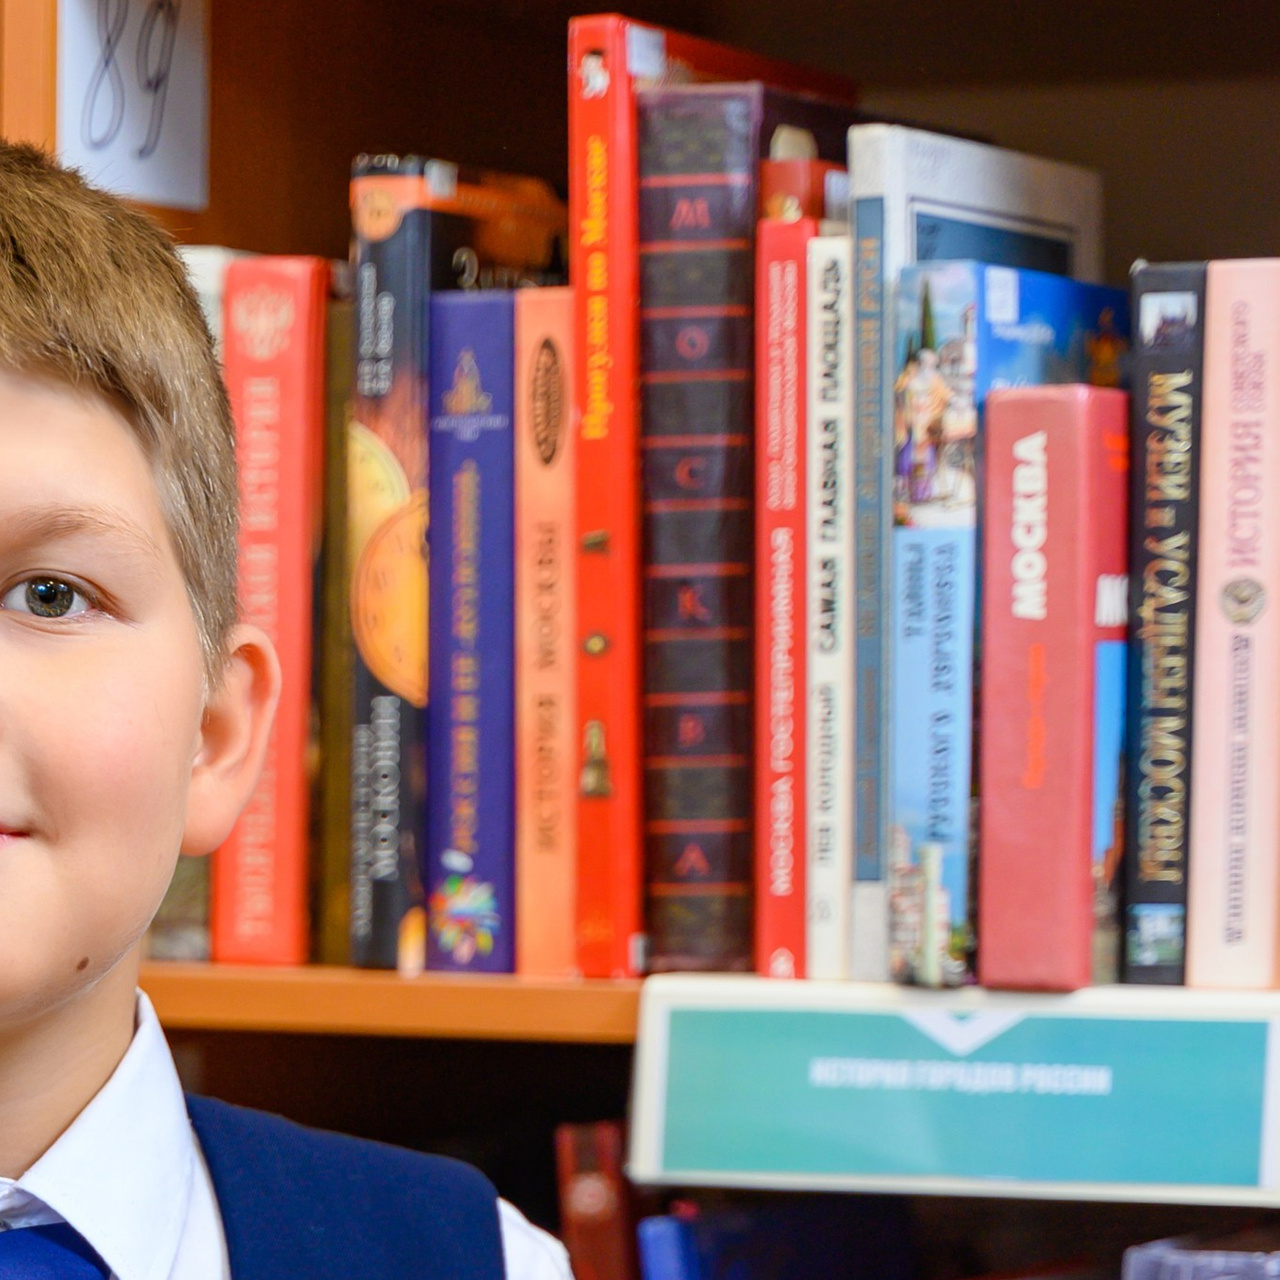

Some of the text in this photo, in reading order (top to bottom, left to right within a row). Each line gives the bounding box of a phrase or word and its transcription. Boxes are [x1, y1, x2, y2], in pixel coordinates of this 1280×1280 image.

[79, 0, 178, 127] 89
[581, 135, 609, 246] Москве
[585, 252, 609, 289] по
[817, 257, 842, 654] САМАЯ ГЛАВНАЯ ПЛОЩАДЬ
[1146, 368, 1193, 504] МУЗЕИ
[1225, 419, 1262, 568] ИСТОРИЯ
[1009, 431, 1048, 620] МОСКВА
[1136, 531, 1191, 709] УСАДЬБЫ
[769, 528, 795, 896] МОСКВА ГОСТЕПРИИМНАЯ
[1138, 716, 1188, 884] МОСКВЫ
[810, 1056, 1113, 1097] ИСТОРИЯ ГОРОДОВ РОССИИ
